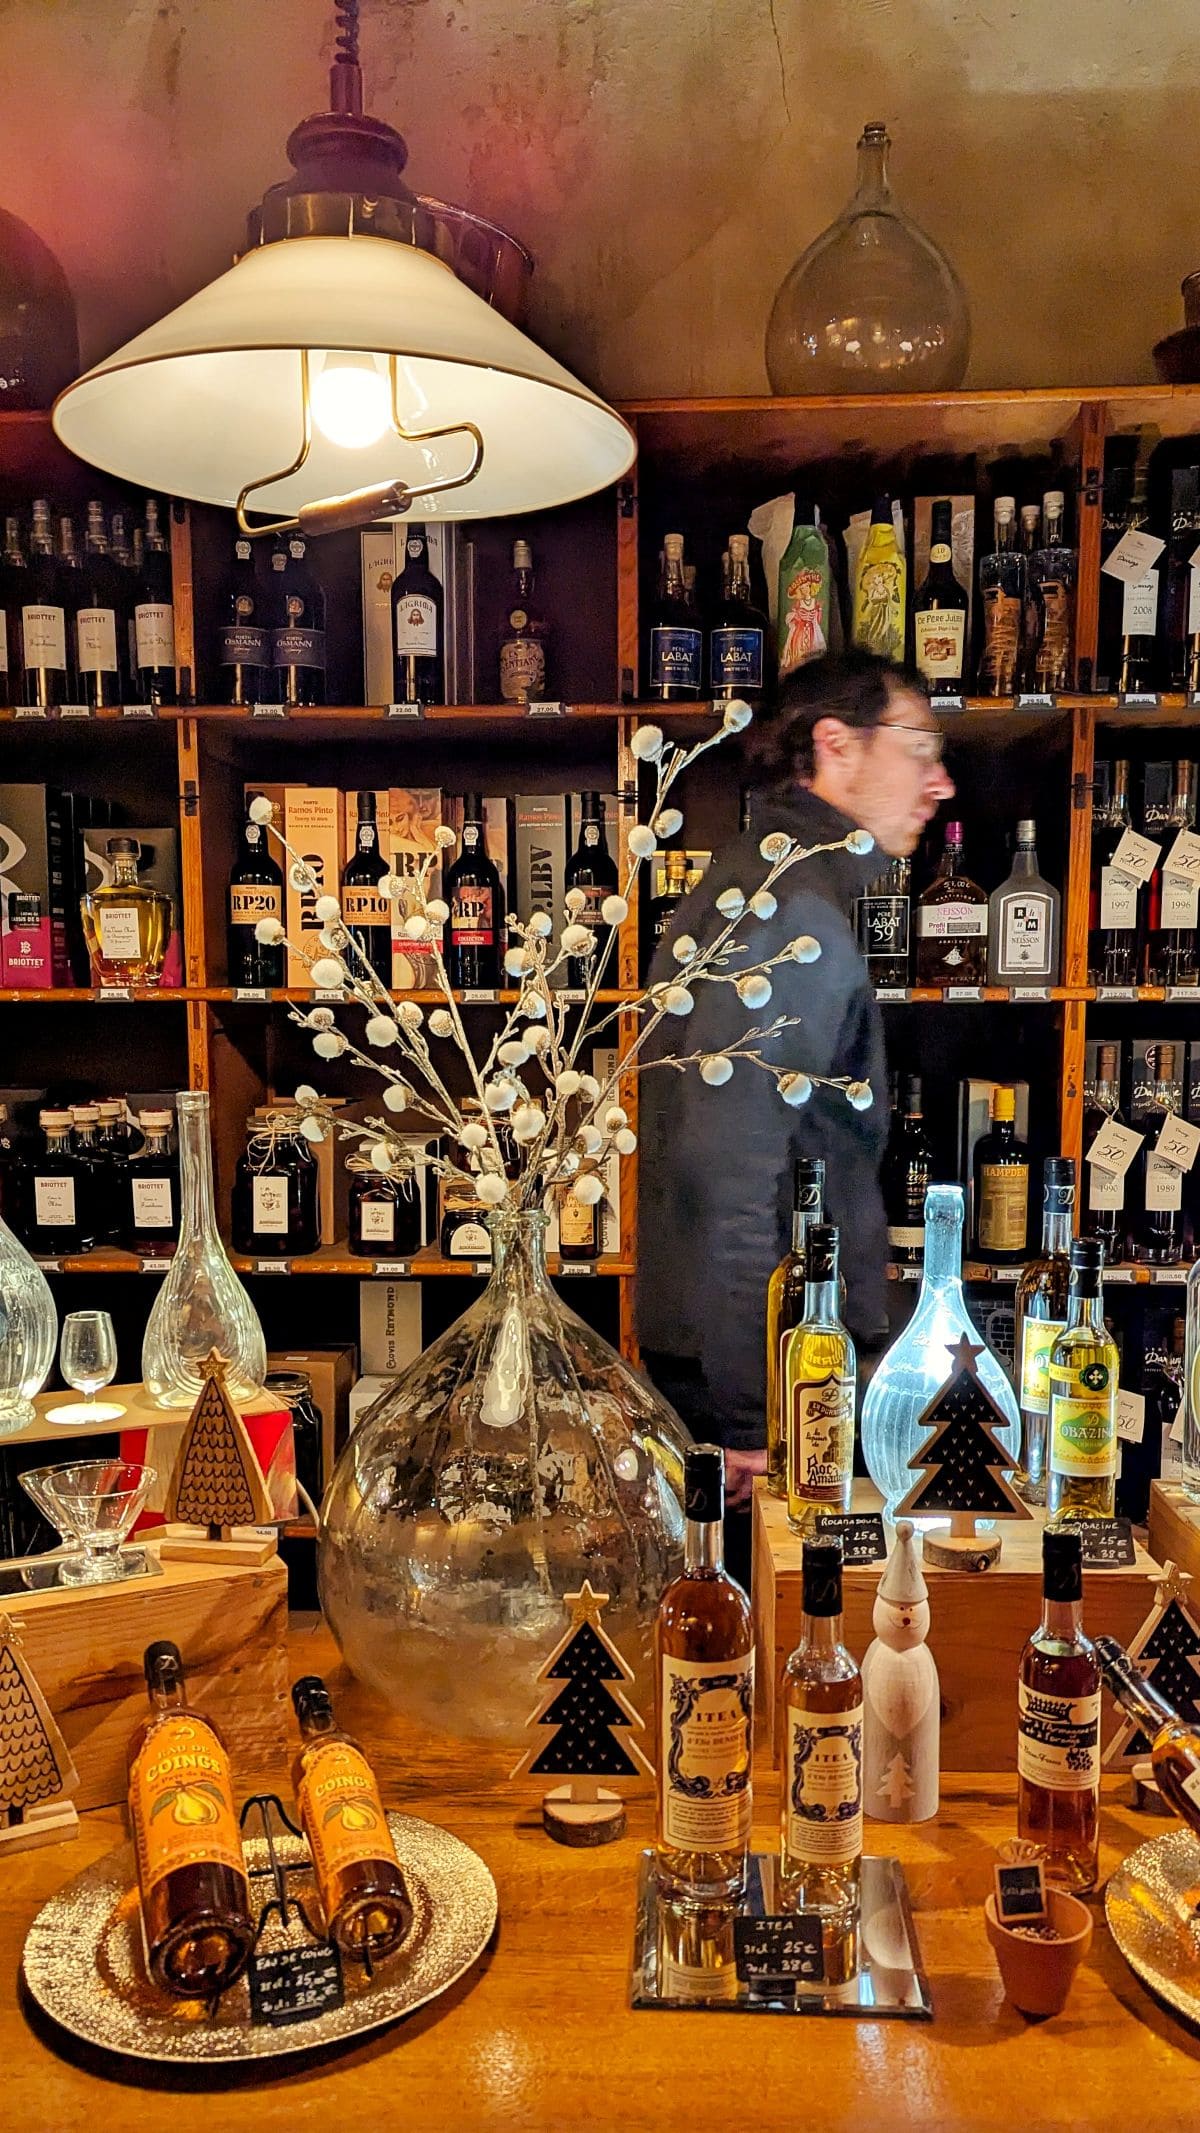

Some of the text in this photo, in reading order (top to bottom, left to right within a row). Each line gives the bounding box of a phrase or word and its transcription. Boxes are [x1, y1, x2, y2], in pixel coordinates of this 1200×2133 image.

[1132, 606, 1153, 615] 2008
[224, 638, 262, 647] OSMANN
[276, 639, 313, 648] OSMANN
[661, 652, 694, 663] LABAT
[720, 652, 753, 663] LABAT
[288, 806, 334, 814] Ramos Pinto
[233, 895, 276, 911] RP20
[345, 897, 388, 913] RP10
[1111, 900, 1130, 909] 1997
[1171, 901, 1191, 910] 1996
[459, 901, 484, 918] RP
[936, 906, 974, 916] NEISSON
[105, 912, 131, 920] BRIOTTET
[867, 917, 901, 928] LABAT
[874, 925, 894, 942] 59
[1011, 936, 1040, 944] NEISSON
[8, 957, 44, 967] BRIOTTET
[983, 1167, 1027, 1177] HAMPDEN
[1156, 1184, 1176, 1193] 1989
[386, 1286, 398, 1370] CLOVIS REYMOND
[853, 1531, 879, 1541] 25€
[1099, 1536, 1128, 1546] 25€
[852, 1546, 878, 1556] 38€
[1101, 1549, 1128, 1559] 38€
[696, 1710, 737, 1723] ITEA
[814, 1754, 849, 1763] ITEA
[145, 1754, 222, 1783] COINGS
[755, 1920, 794, 1931] ITEA
[782, 1940, 818, 1955] 25€
[256, 1957, 278, 1971] EAU
[781, 1959, 816, 1973] 38€
